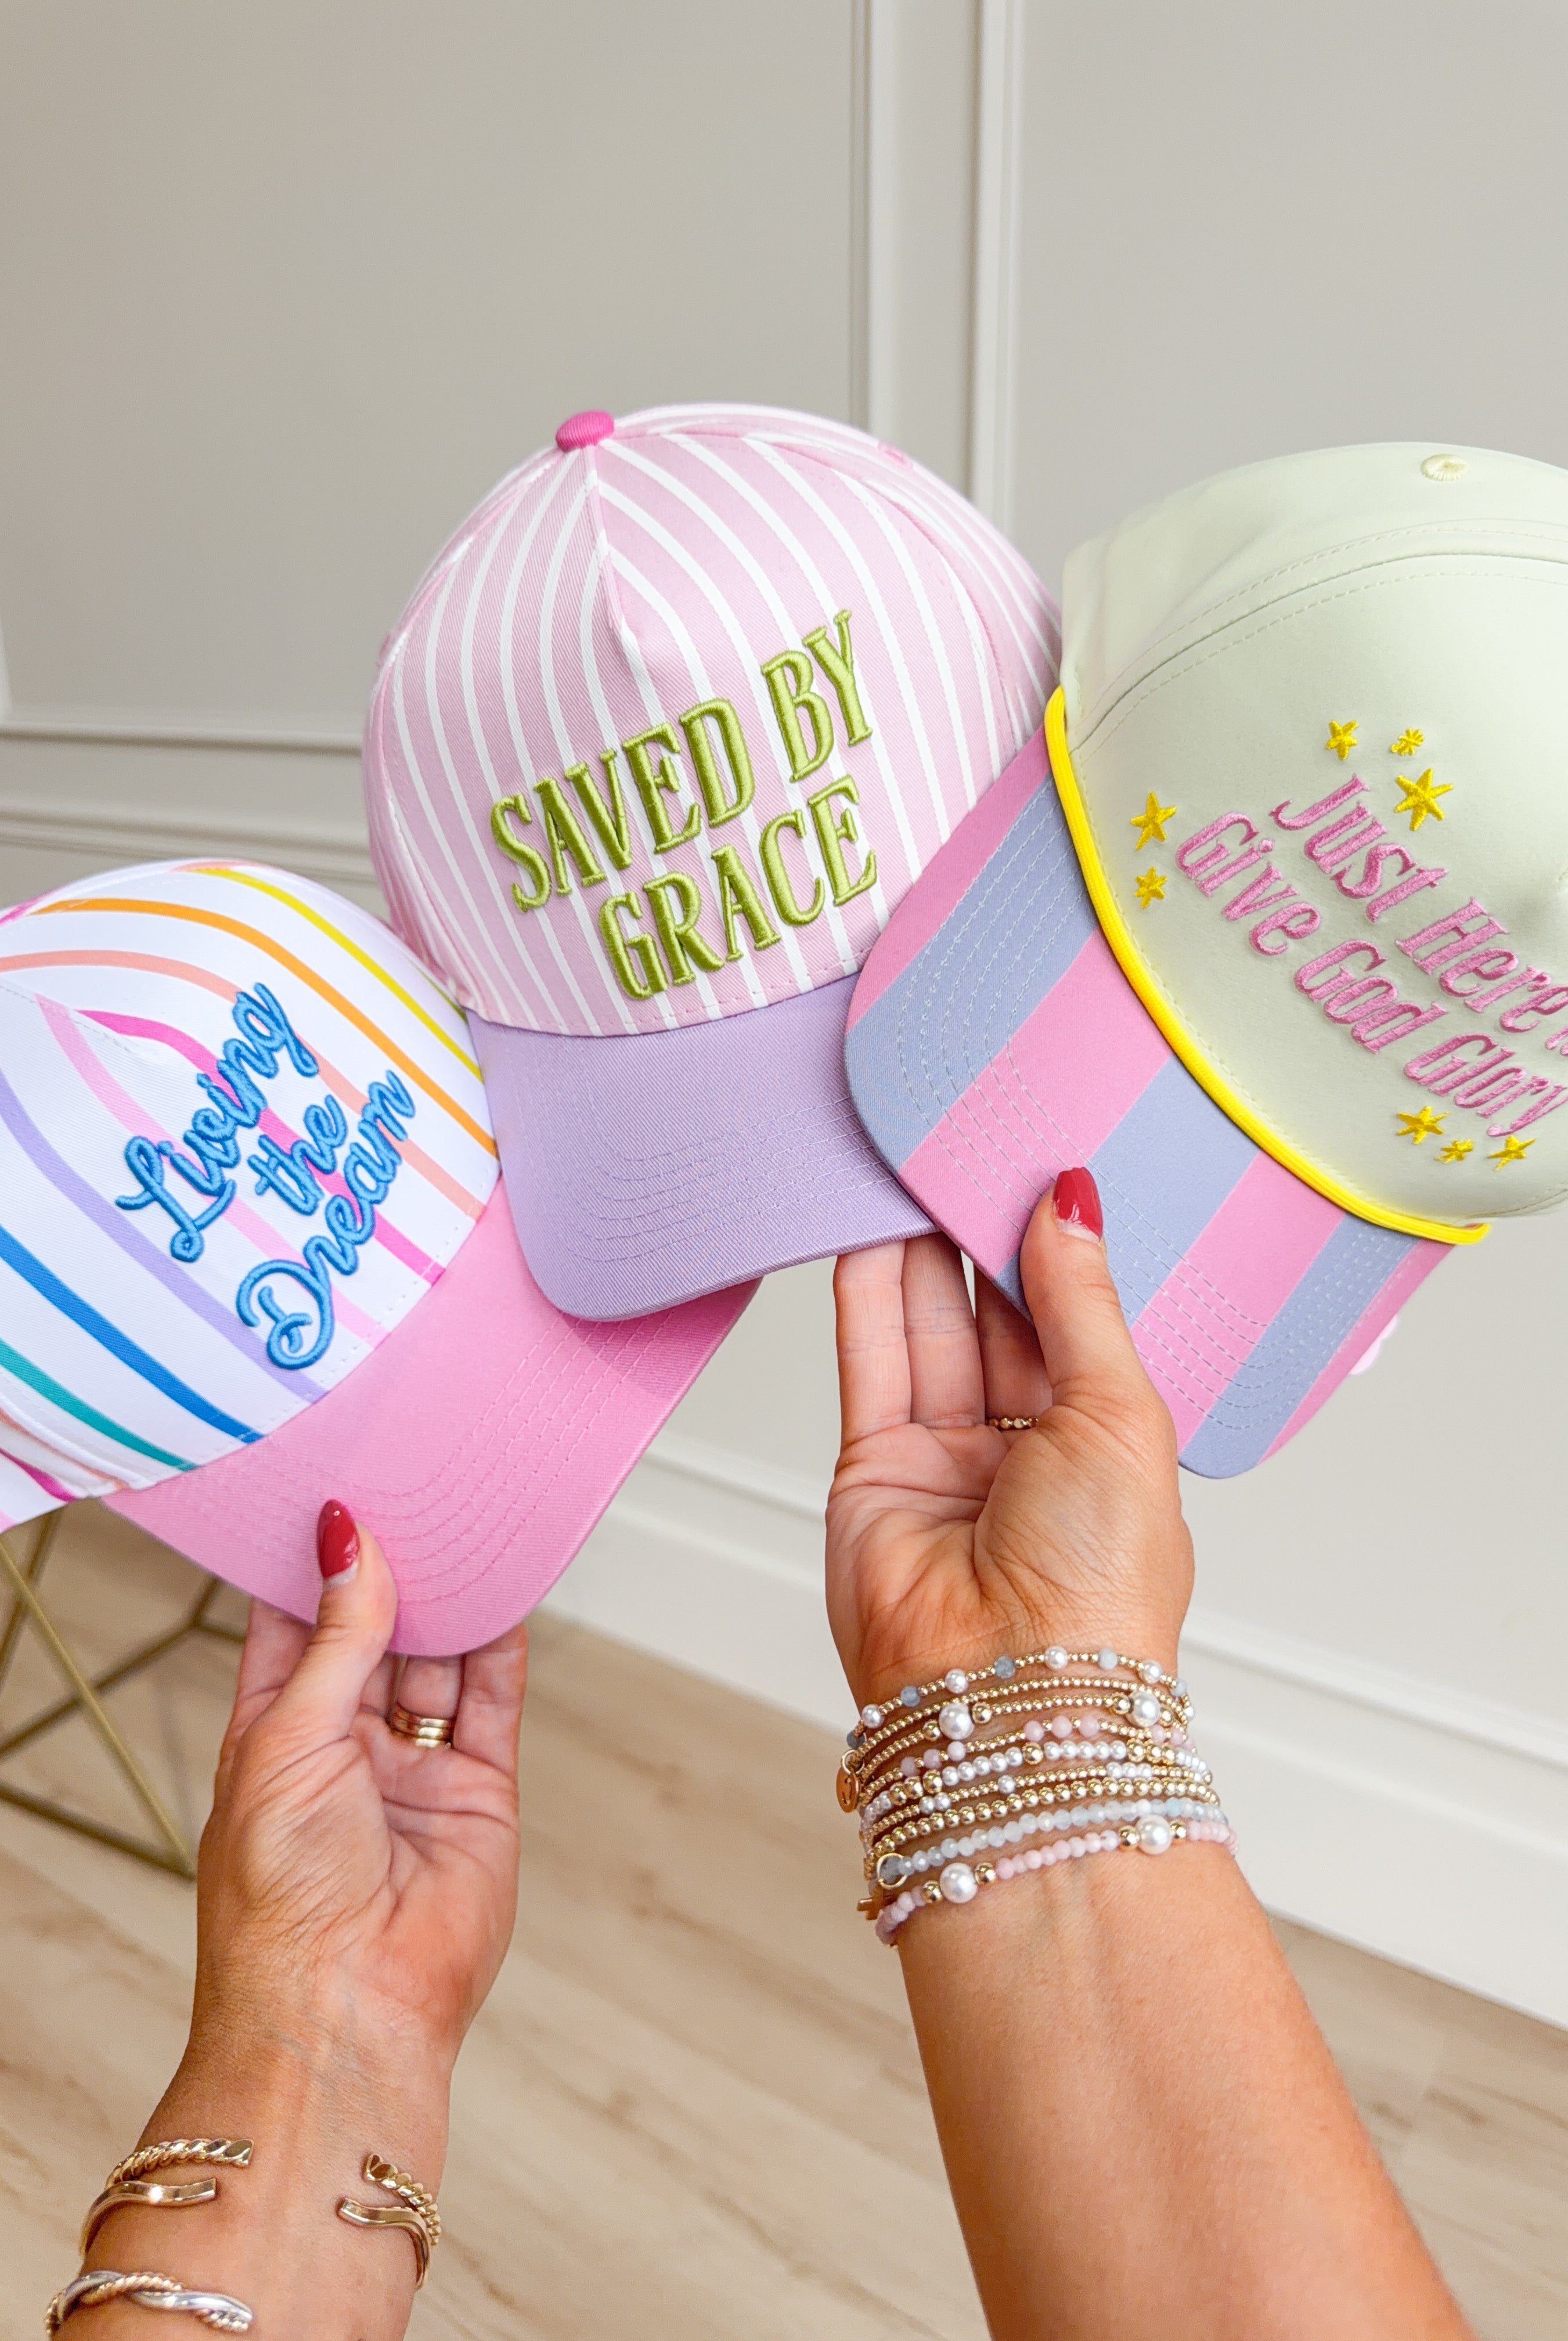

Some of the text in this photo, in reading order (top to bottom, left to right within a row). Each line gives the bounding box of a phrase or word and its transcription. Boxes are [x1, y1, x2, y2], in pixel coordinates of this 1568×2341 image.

[489, 609, 873, 913] SAVED BY
[598, 774, 878, 999] GRACE
[1174, 812, 1568, 1137] Give God Glory
[1270, 773, 1568, 1033] Just Here
[115, 982, 320, 1263] Living
[236, 1069, 416, 1370] Dream
[247, 1094, 348, 1216] the
